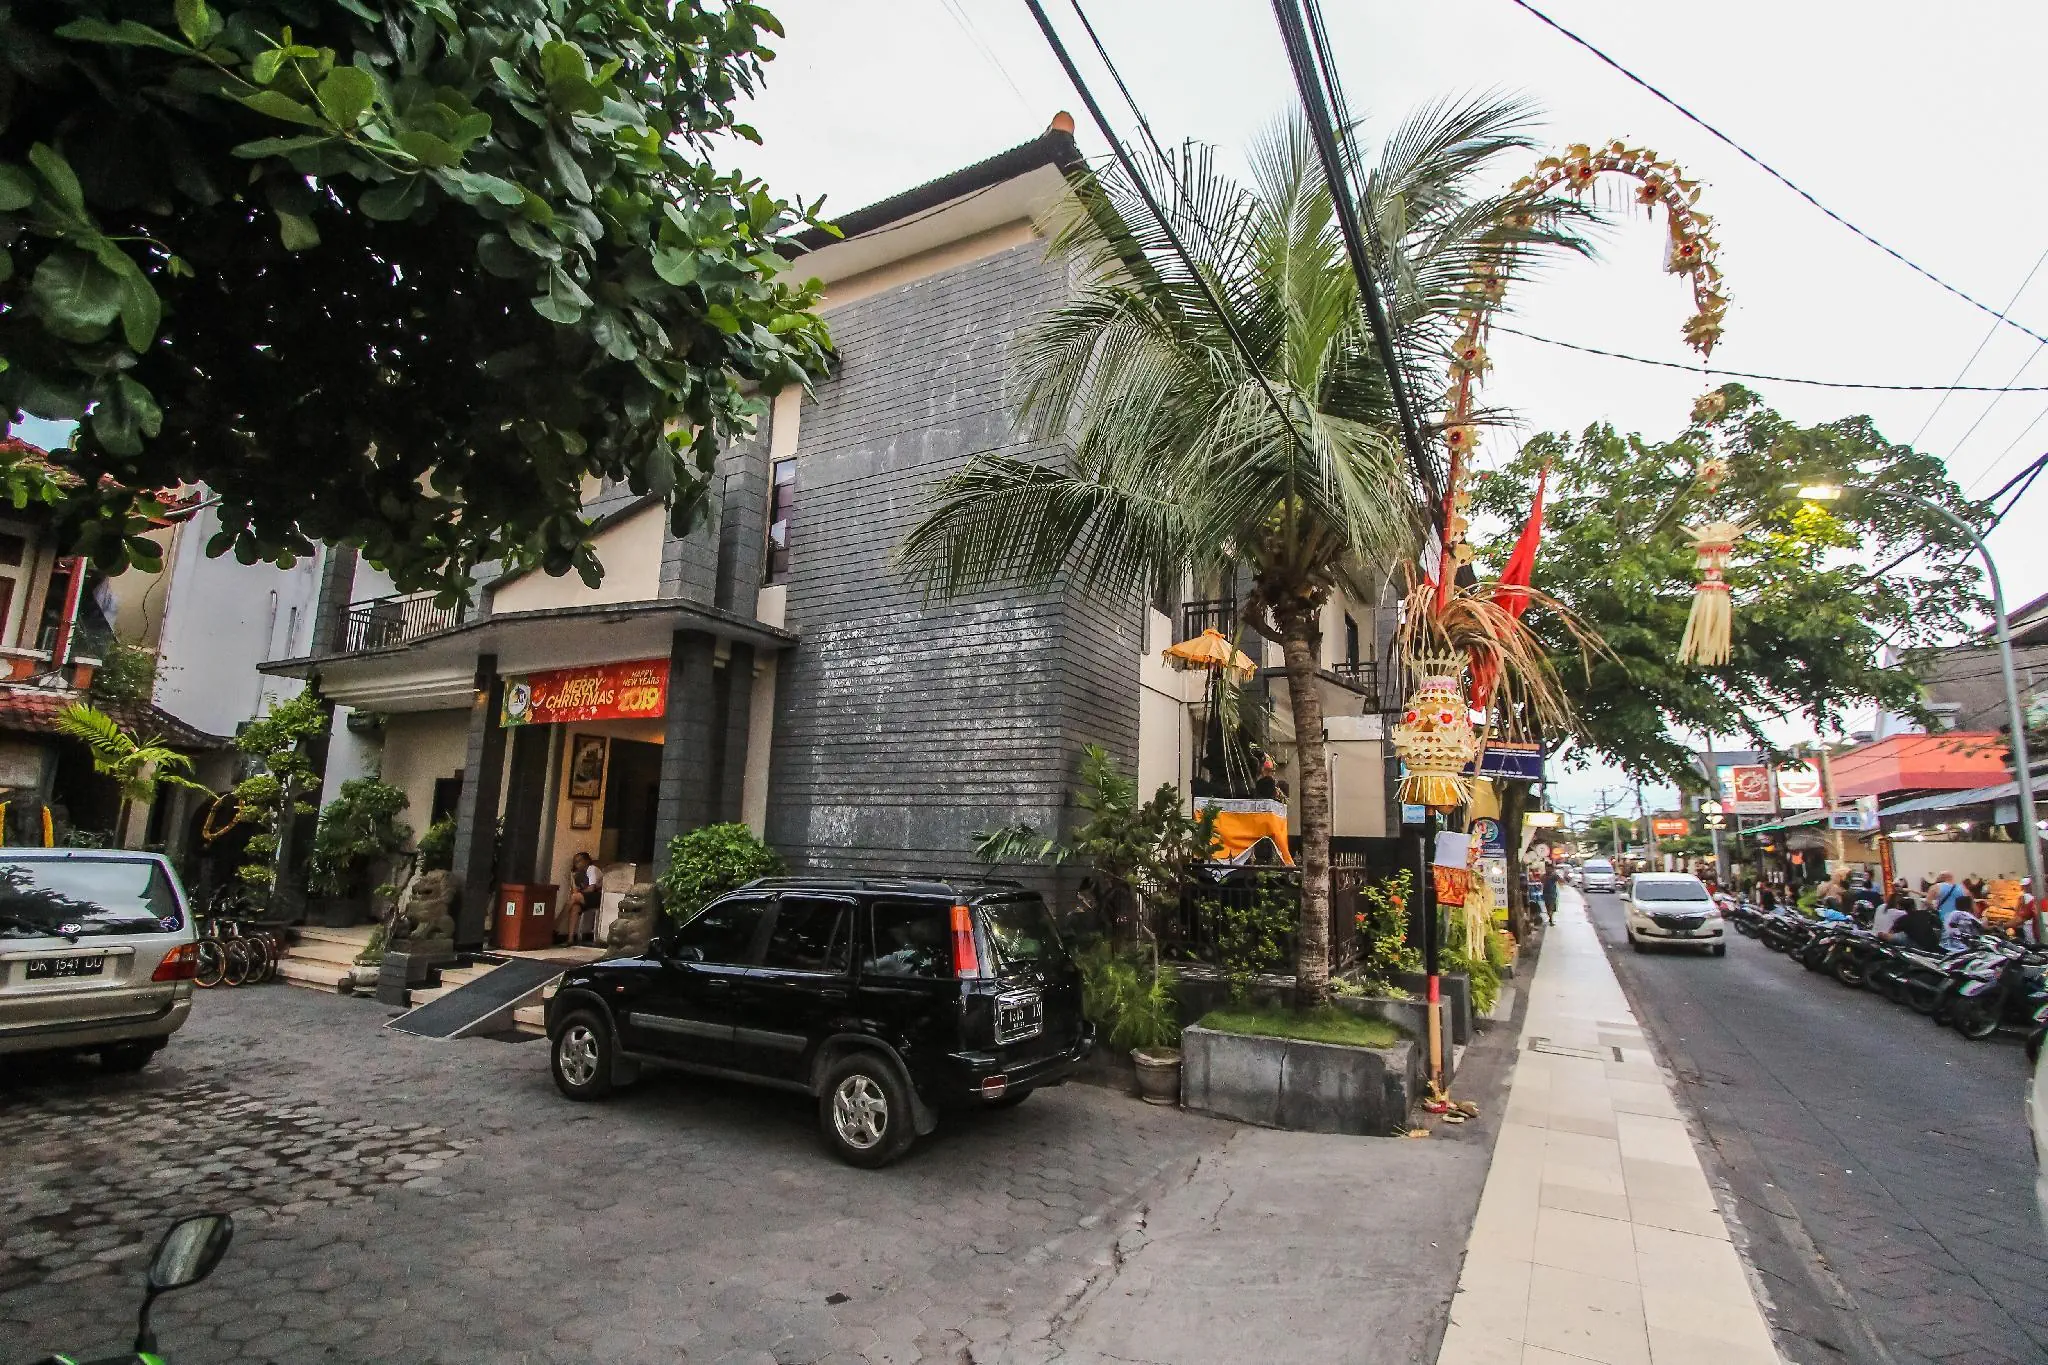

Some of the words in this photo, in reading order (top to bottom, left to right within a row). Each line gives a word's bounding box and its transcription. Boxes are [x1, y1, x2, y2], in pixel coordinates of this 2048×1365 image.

[623, 678, 638, 686] NEW
[639, 676, 660, 686] YEARS
[632, 669, 654, 678] HAPPY
[561, 678, 602, 696] MERRY
[545, 690, 615, 710] CHRISTMAS
[618, 687, 660, 712] 2019
[30, 960, 47, 971] DK
[55, 958, 79, 970] 1541
